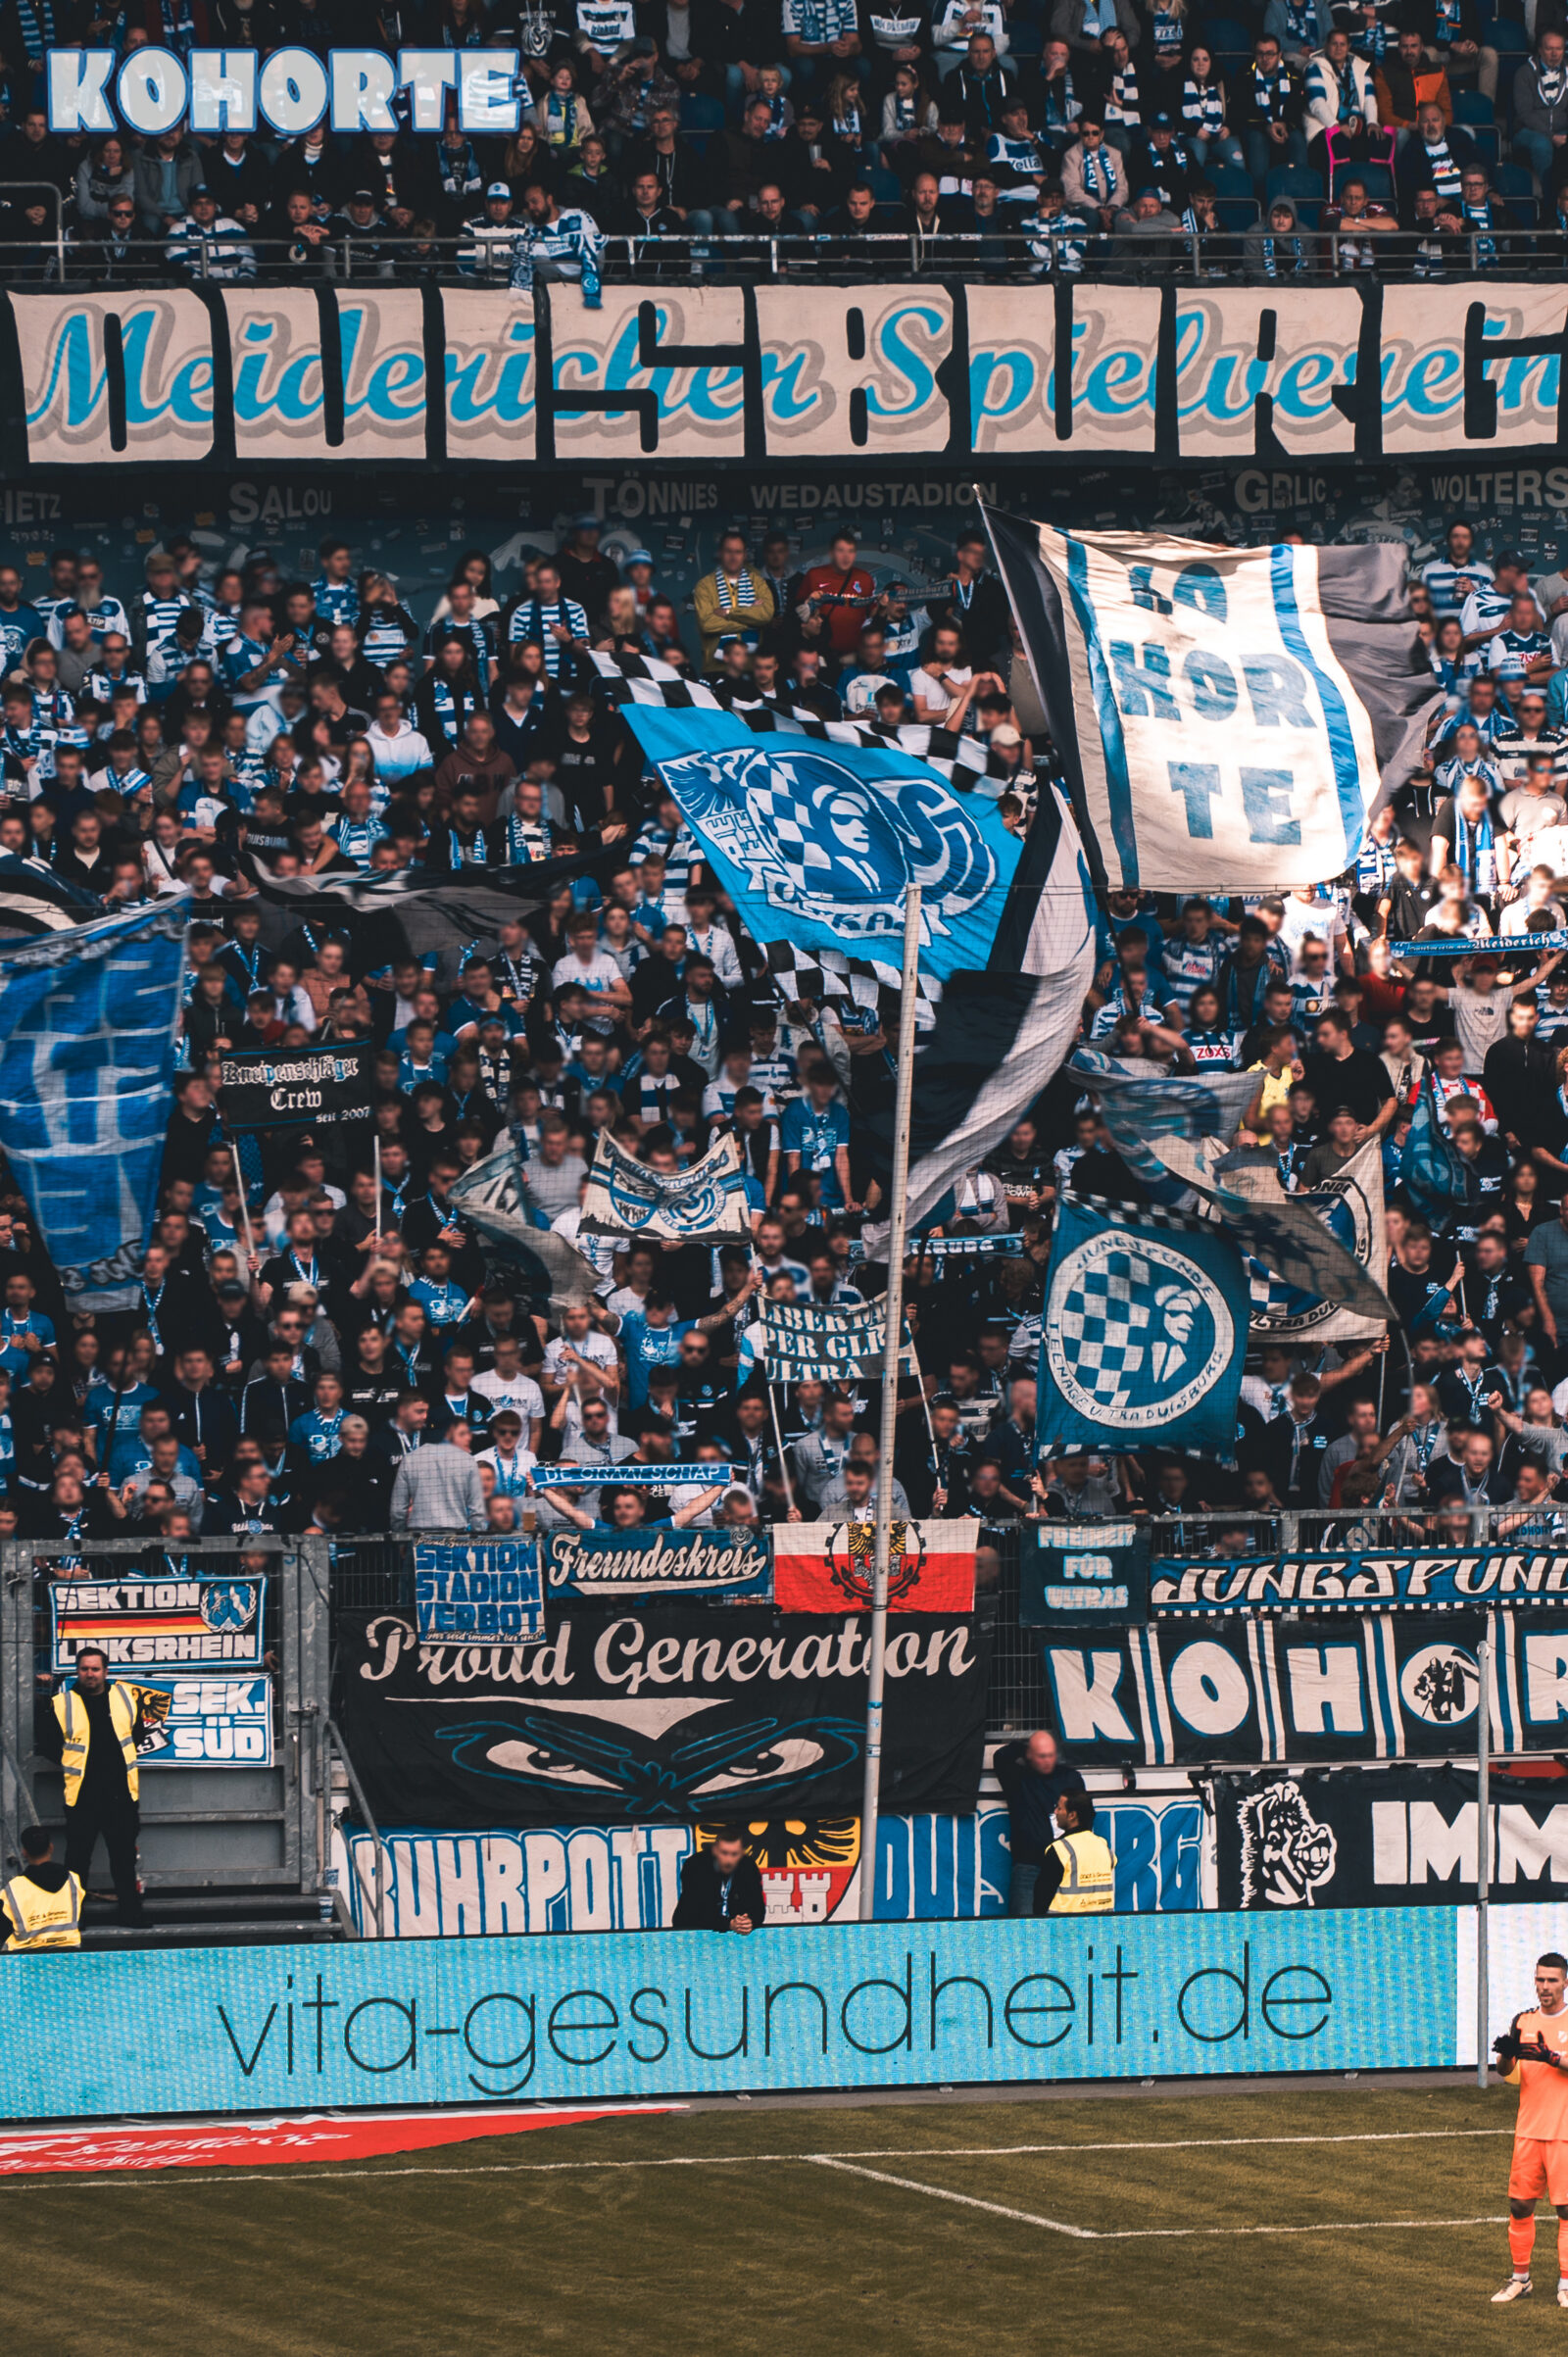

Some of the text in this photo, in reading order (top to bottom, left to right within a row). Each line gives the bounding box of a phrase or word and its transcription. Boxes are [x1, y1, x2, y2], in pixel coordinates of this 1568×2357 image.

[227, 481, 332, 523] SALOU
[581, 470, 718, 518] TÖNNIES
[750, 481, 999, 510] WEDAUSTADION
[1431, 466, 1568, 509] WOLTERS
[0, 489, 62, 524] IETZ
[1166, 761, 1301, 846] TE
[1472, 933, 1550, 952] Meiderich
[1196, 1045, 1232, 1060] ZOXS
[221, 1055, 360, 1087] Kneipenschläger
[270, 1087, 322, 1110] Crew
[315, 1105, 371, 1124] seit 2007
[760, 1323, 819, 1359] PER
[763, 1355, 865, 1382] ULTRÀ
[545, 1467, 572, 1482] DE
[1039, 1524, 1137, 1549] FREIHEIT
[416, 1543, 538, 1572] SEKTION
[549, 1532, 766, 1583] Freundeskreis
[1063, 1552, 1113, 1579] FÜR
[56, 1582, 201, 1610] SEKTION
[416, 1571, 541, 1602] STADION
[1045, 1585, 1129, 1609] ULTRAS
[416, 1601, 542, 1635] VERBOT
[360, 1615, 976, 1695] Proud Generaton
[172, 1682, 265, 1715] SEK.
[173, 1716, 265, 1759] SÜD
[874, 1801, 1204, 1919] DUISRG
[343, 1827, 694, 1939] RUHRPOTT
[217, 1940, 1333, 2095] vita-gesundheit.de
